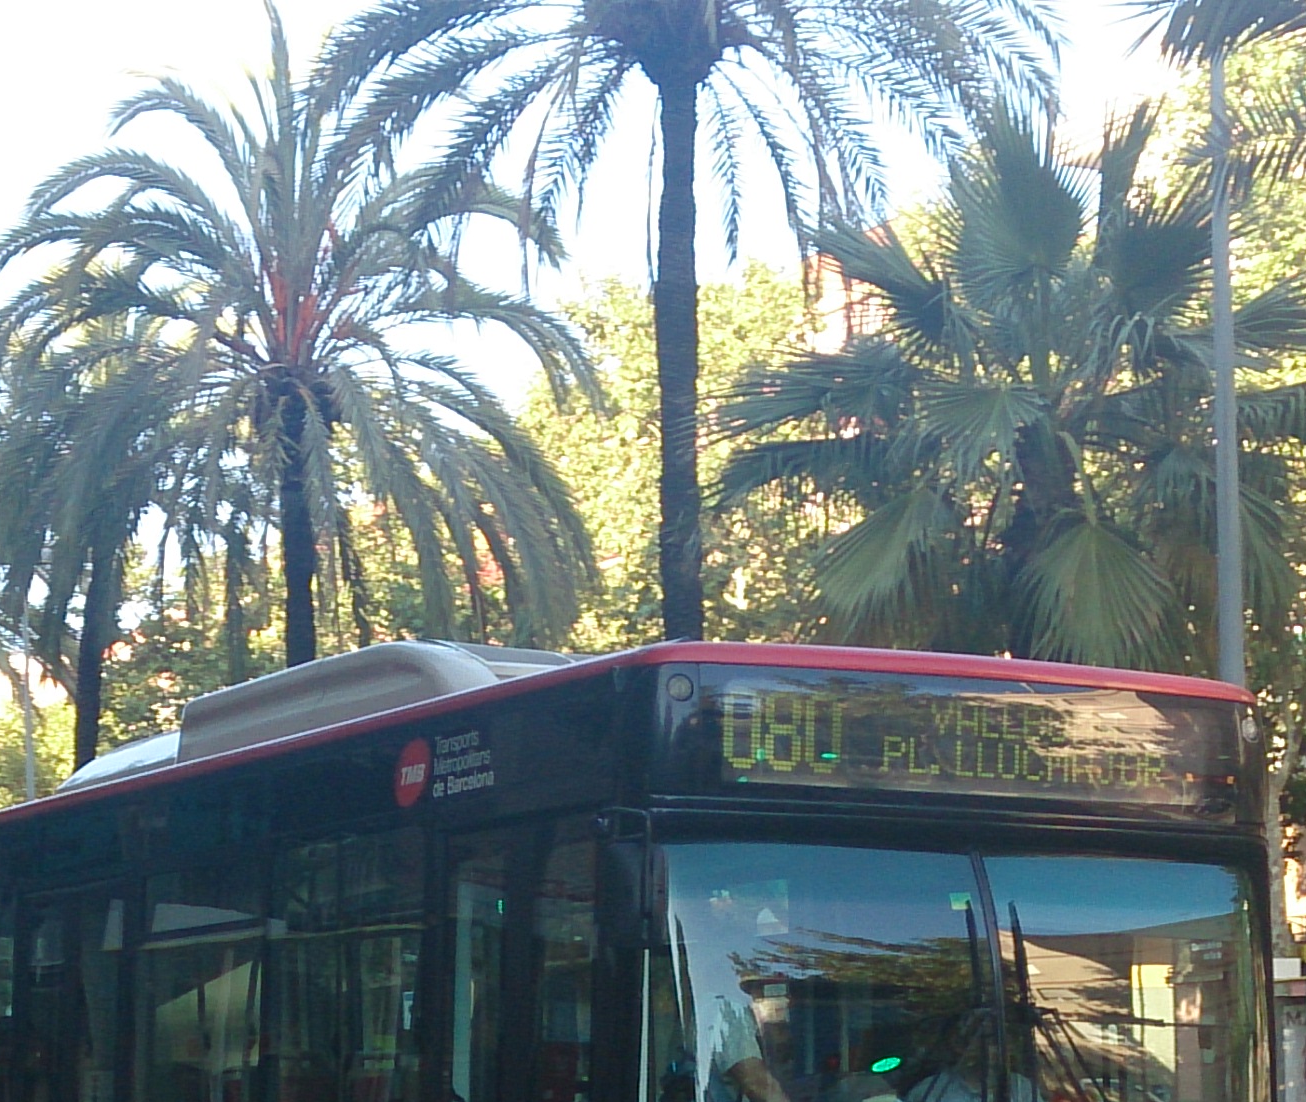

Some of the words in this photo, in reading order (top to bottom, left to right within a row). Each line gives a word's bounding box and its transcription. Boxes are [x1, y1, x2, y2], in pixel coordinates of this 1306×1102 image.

[435, 730, 479, 755] Transports
[401, 763, 426, 786] TMB
[433, 749, 491, 776] Metropolitans
[884, 736, 940, 775] PL.
[954, 739, 1166, 788] LLUCMAJOR
[432, 780, 445, 798] de
[447, 769, 494, 795] Barcelona
